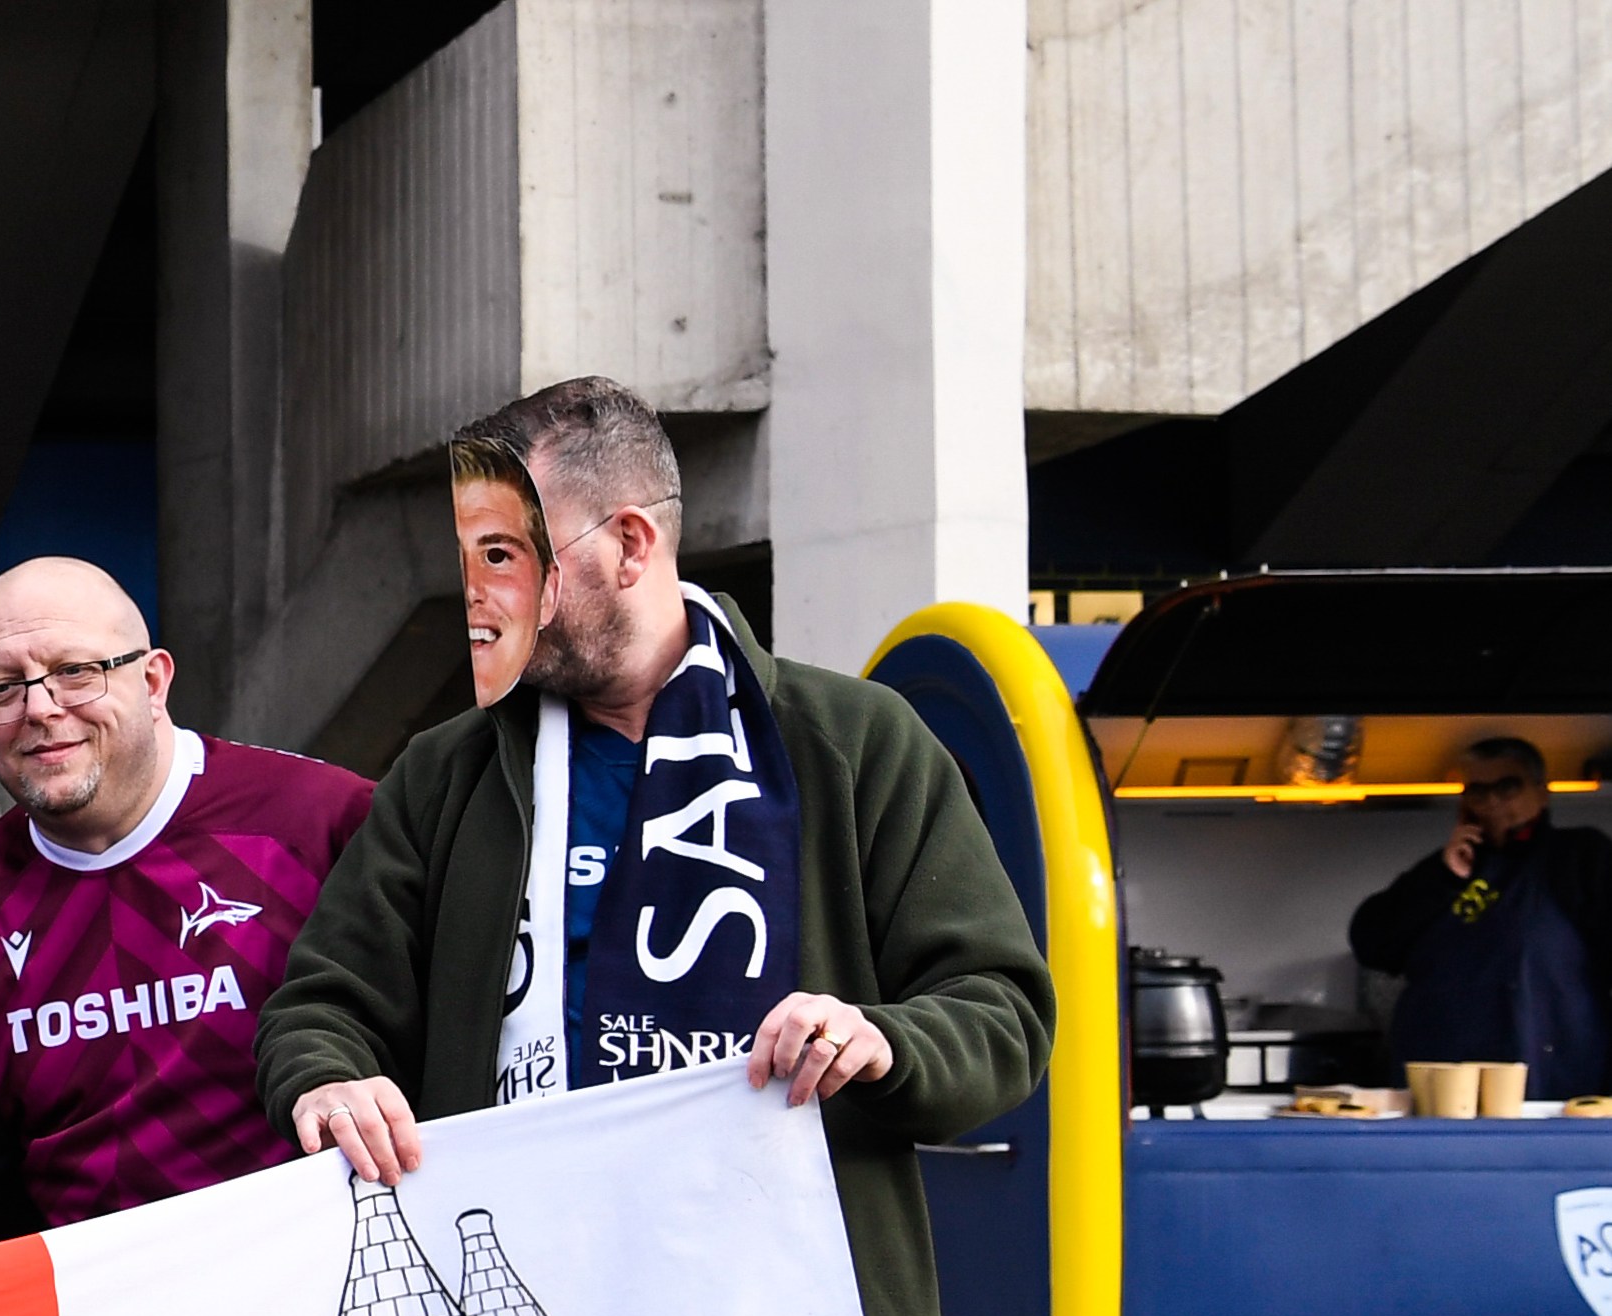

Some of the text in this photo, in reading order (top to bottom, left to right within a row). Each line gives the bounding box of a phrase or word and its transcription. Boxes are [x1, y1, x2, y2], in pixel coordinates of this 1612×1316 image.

[6, 965, 247, 1054] TOSHIBA
[599, 1014, 655, 1033] SALE
[598, 1028, 753, 1073] SHARK
